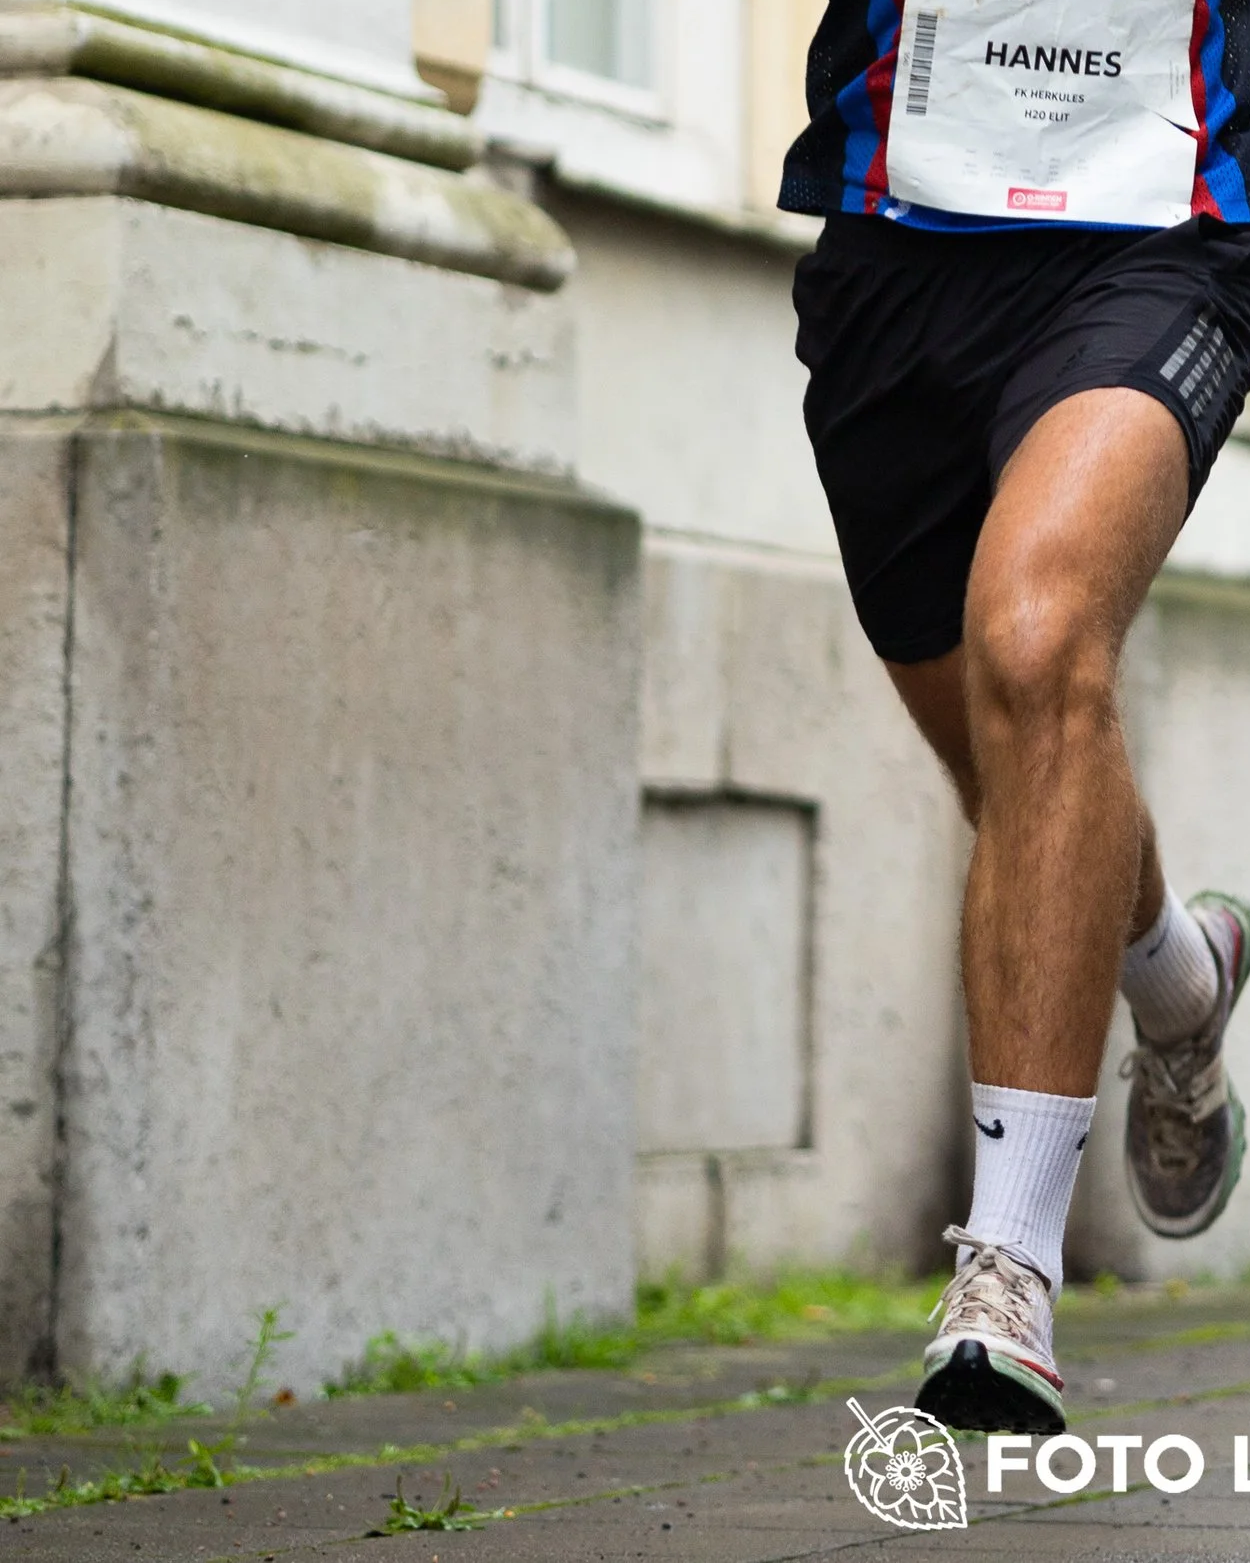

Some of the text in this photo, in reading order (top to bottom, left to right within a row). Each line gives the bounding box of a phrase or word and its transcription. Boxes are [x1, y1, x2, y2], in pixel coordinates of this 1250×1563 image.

[985, 41, 1122, 78] HANNES
[1014, 88, 1085, 103] FK HERKULES
[1024, 109, 1070, 122] H20 ELIT
